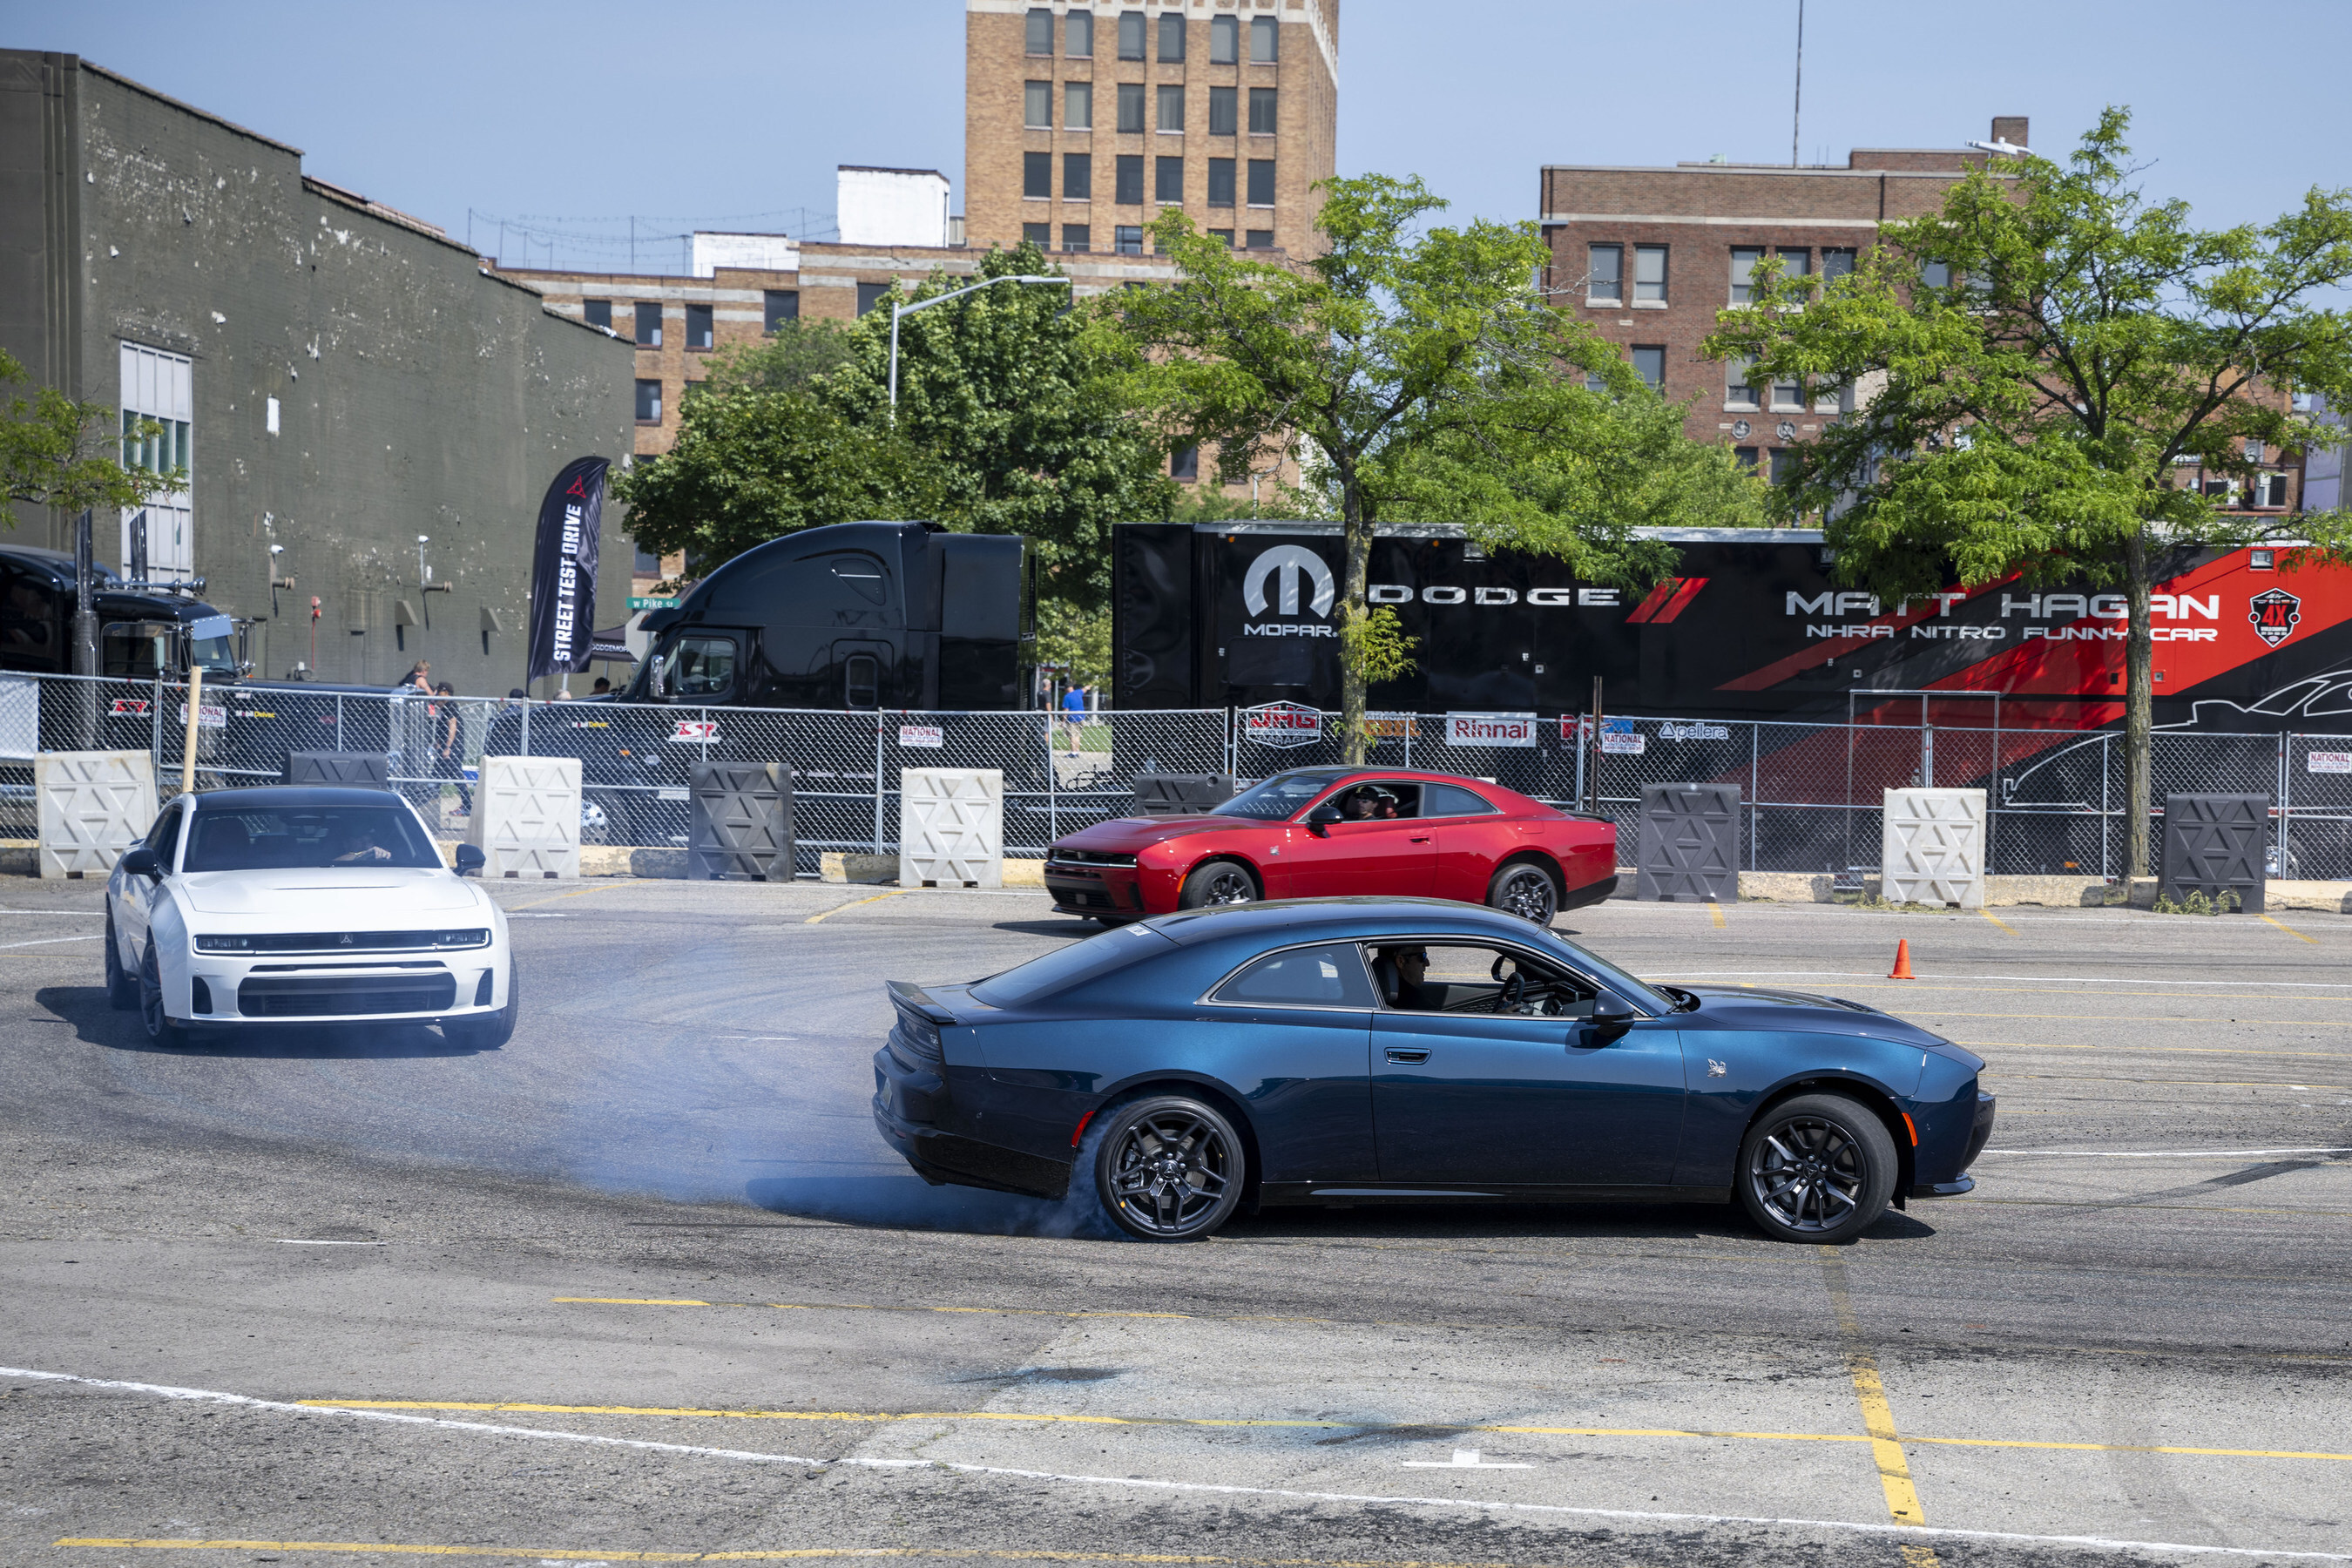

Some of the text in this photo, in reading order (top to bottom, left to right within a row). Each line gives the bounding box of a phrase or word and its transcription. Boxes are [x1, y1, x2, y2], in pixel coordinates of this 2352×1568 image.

[552, 504, 582, 662] STREET TEST DRIVE
[643, 598, 662, 608] Pike
[1369, 585, 1619, 606] DODGE
[2001, 593, 2220, 619] HAGAN
[2261, 605, 2288, 626] 4X
[1244, 624, 1334, 637] MOPAR
[1806, 625, 2219, 641] NHRA NITRO FUNNY CAR
[183, 704, 223, 716] NIONAL
[1249, 705, 1317, 728] JHG
[902, 727, 940, 737] NATIONAL
[1456, 720, 1528, 739] Rinnai
[1604, 734, 1642, 744] NATIONAL
[2310, 753, 2349, 762] NATIONAL
